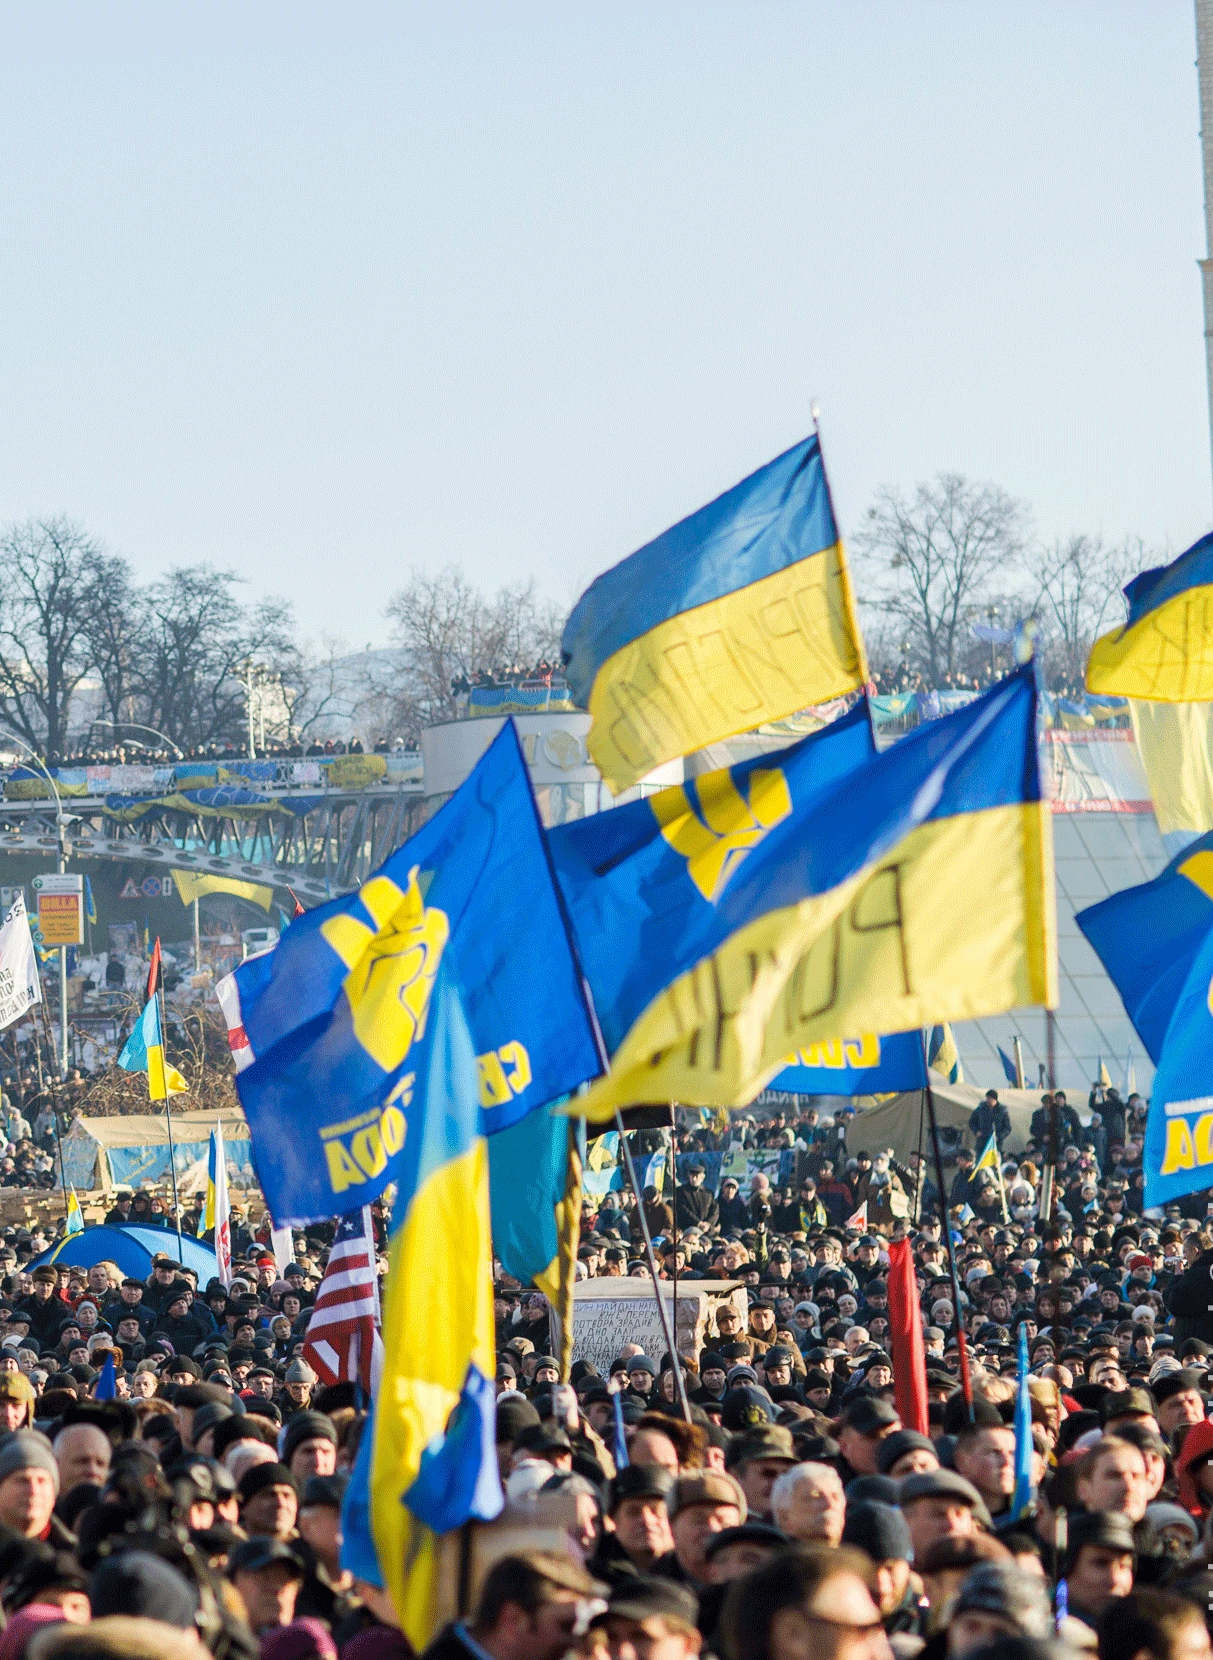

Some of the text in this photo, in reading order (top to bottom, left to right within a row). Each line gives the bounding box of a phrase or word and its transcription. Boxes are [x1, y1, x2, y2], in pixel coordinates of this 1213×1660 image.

[596, 1302, 636, 1311] МАЙДАН
[638, 1301, 658, 1310] НАРО
[593, 1352, 621, 1360] УКРАЇН
